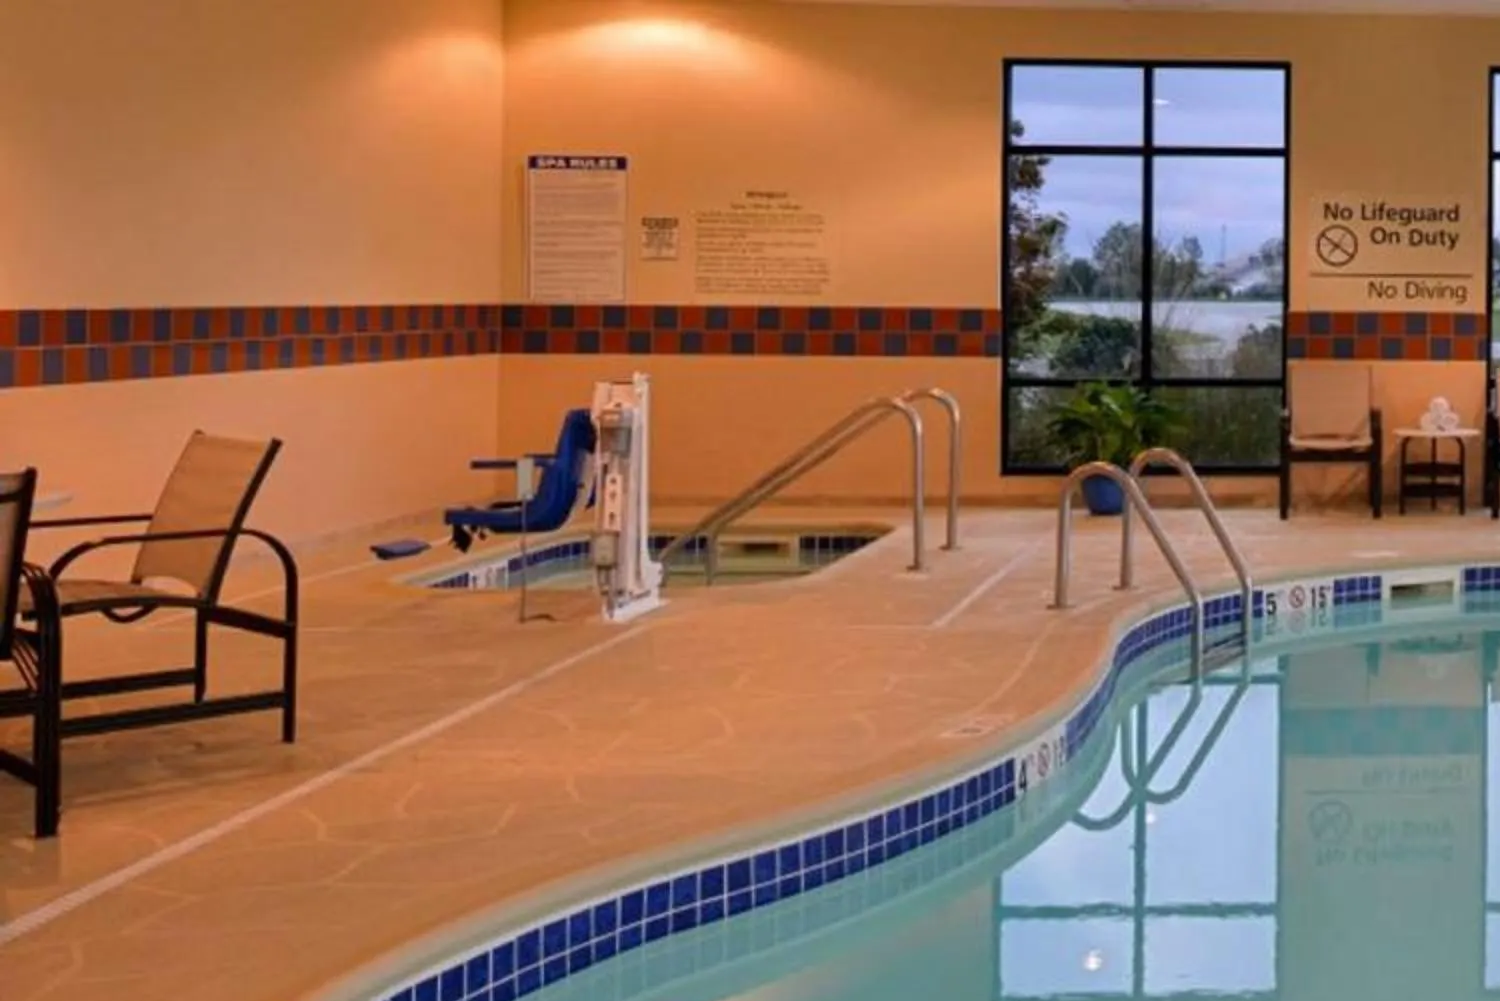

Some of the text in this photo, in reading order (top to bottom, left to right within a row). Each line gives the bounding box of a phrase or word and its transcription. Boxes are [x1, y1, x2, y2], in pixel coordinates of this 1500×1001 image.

[536, 157, 618, 170] SPA RULES
[1323, 203, 1461, 226] No Lifeguard
[1370, 226, 1460, 250] On Duty
[1367, 281, 1468, 304] No Diving
[1265, 592, 1277, 615] 5
